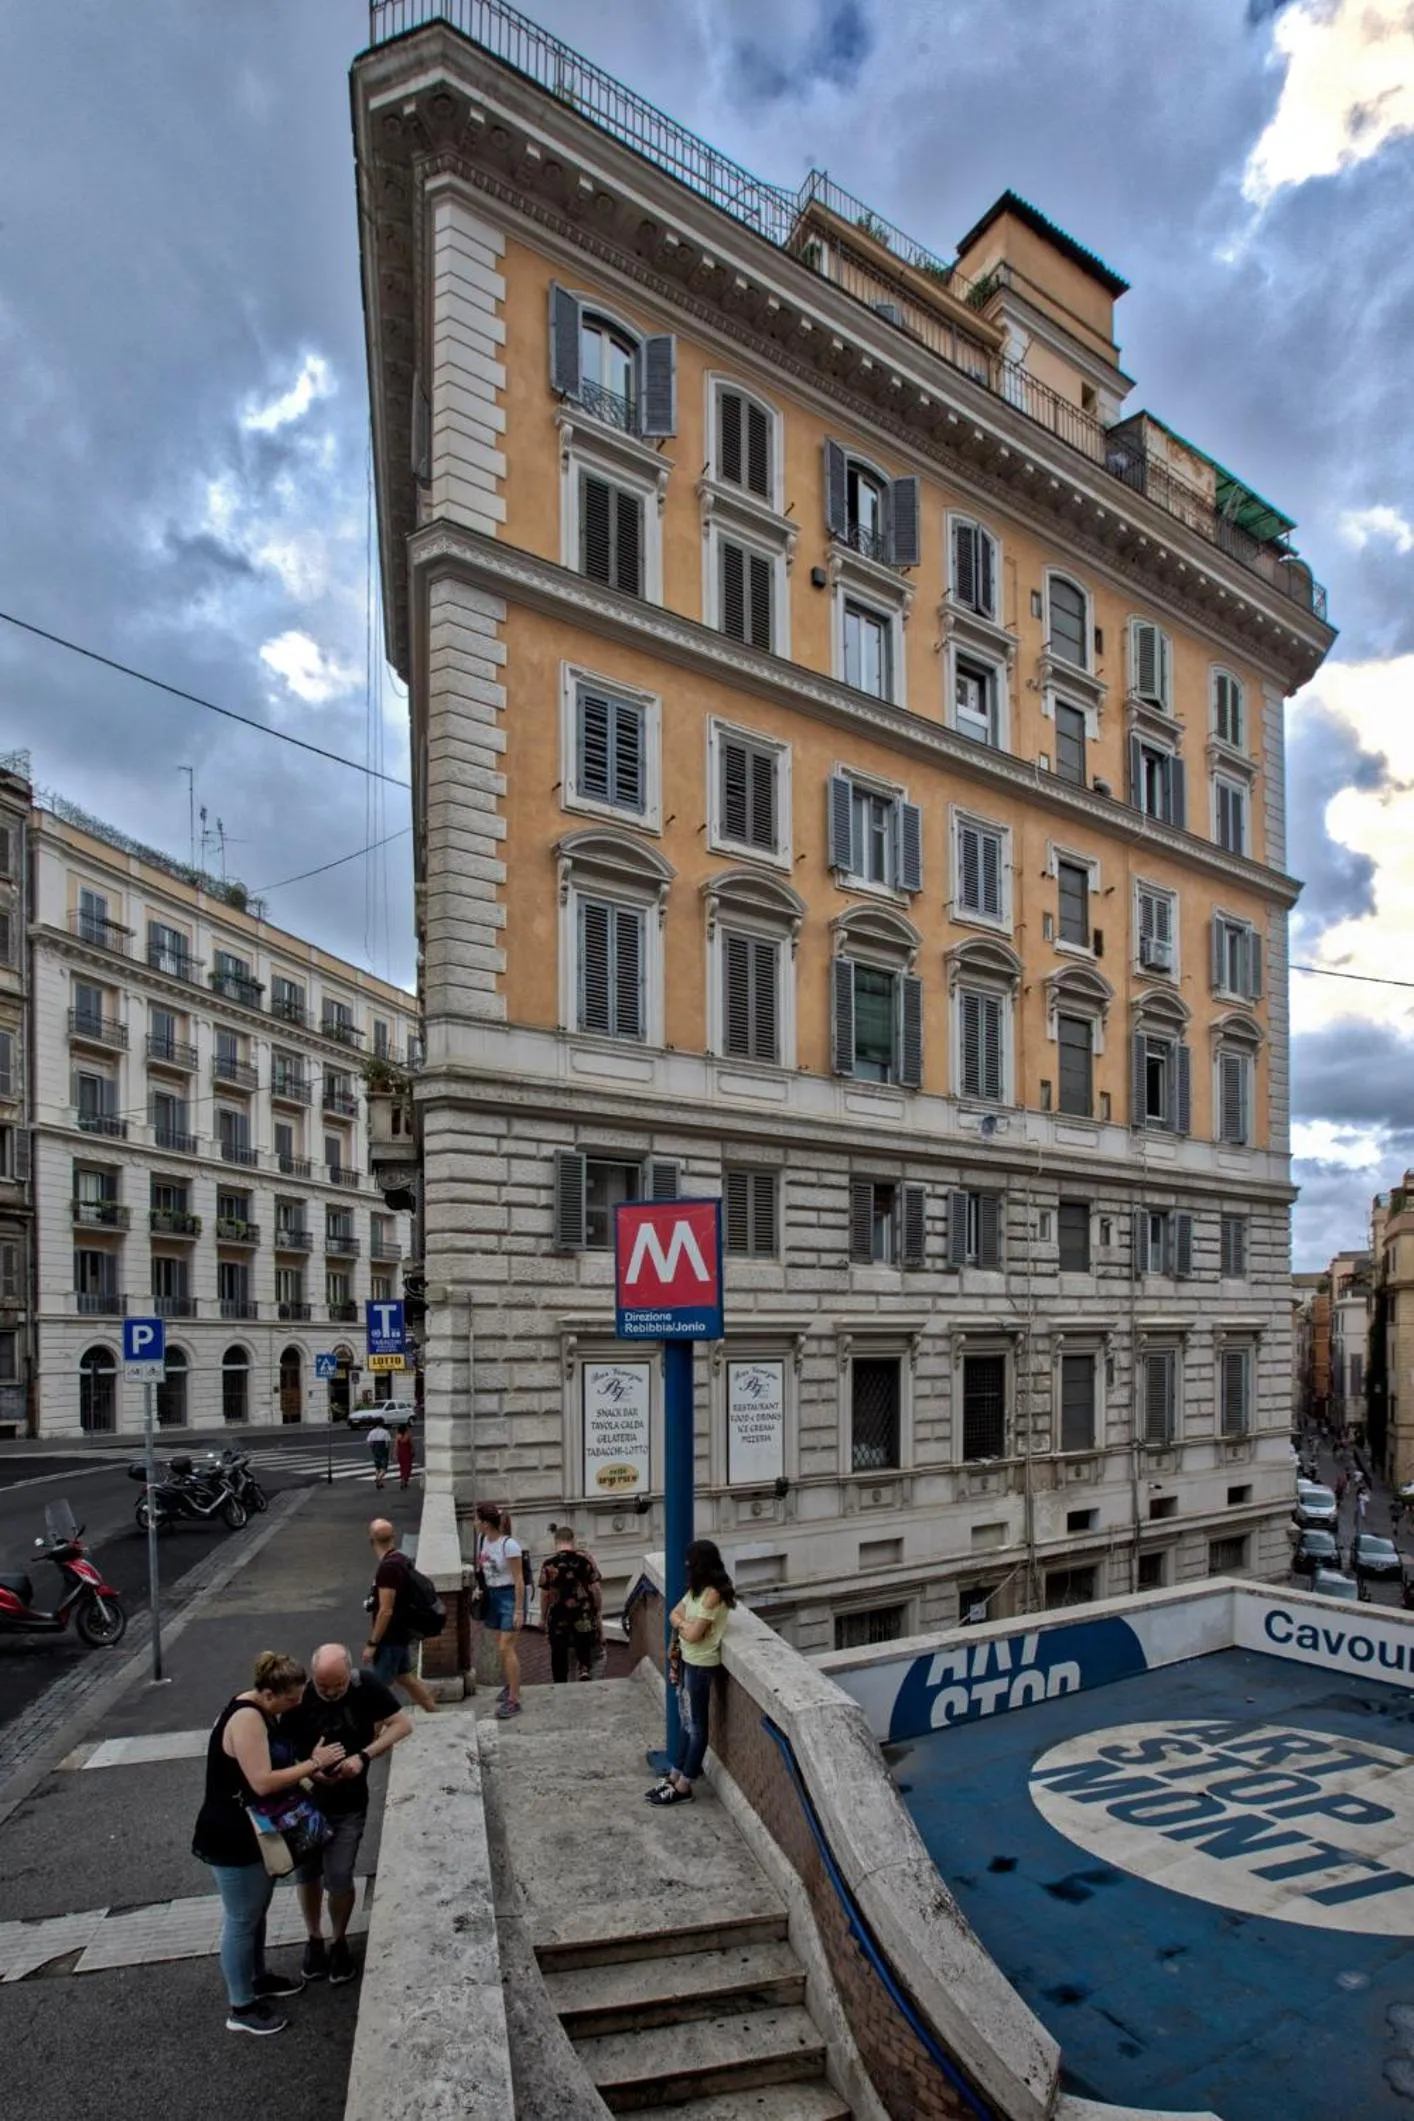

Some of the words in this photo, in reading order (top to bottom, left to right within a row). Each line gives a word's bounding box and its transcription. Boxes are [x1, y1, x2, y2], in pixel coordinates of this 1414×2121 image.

[624, 1220, 711, 1285] M
[373, 1304, 397, 1338] T
[624, 1311, 672, 1321] Direzione
[624, 1322, 706, 1333] Rebibbia/Jonio
[132, 1325, 154, 1355] P
[372, 1356, 402, 1365] LOTTO
[596, 1408, 622, 1418] SNACK
[623, 1407, 639, 1417] BAR
[732, 1402, 779, 1412] RESTAURANT
[590, 1420, 620, 1430] TAVOLA
[620, 1419, 645, 1429] CALDA
[737, 1424, 748, 1433] ICE
[749, 1423, 775, 1432] CREAM
[596, 1433, 638, 1444] GELATERIA
[742, 1434, 772, 1443] PIZZERIA
[1166, 1720, 1408, 1777] ART
[1097, 1737, 1396, 1826] STOP
[1030, 1759, 1414, 1907] MONTI
